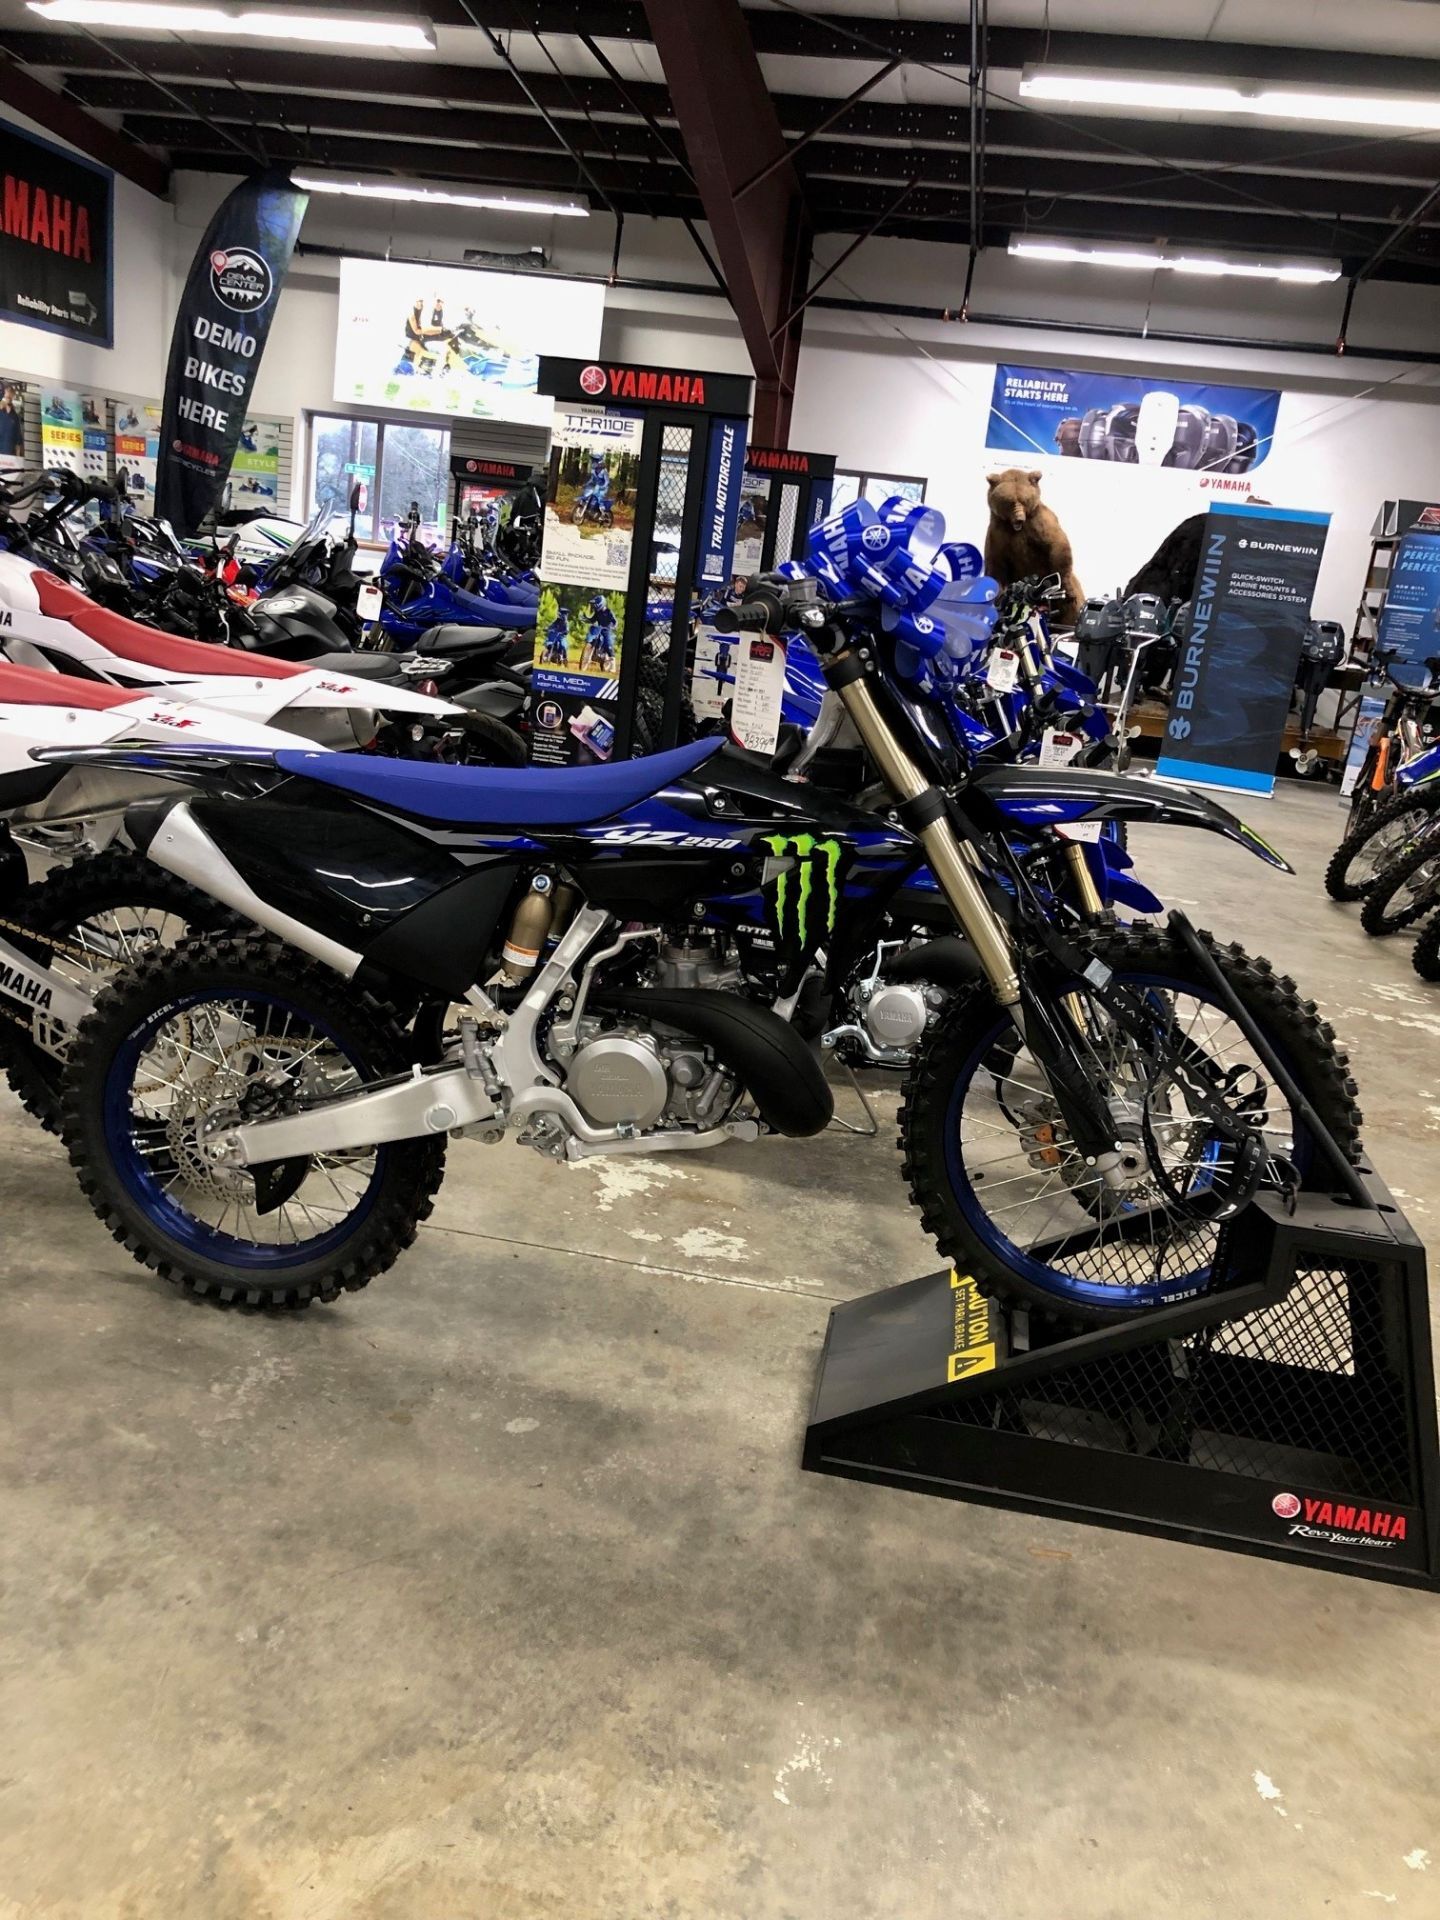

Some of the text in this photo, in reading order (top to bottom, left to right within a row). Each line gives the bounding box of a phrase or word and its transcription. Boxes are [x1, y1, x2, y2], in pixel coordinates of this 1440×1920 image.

[0, 174, 91, 264] MAHA
[219, 277, 264, 291] CENTER
[193, 316, 257, 357] DEMO
[184, 356, 246, 396] BIKES
[609, 368, 705, 405] YAMAHA
[1006, 378, 1066, 392] RELIABILITY
[1004, 387, 1069, 403] STARTS HERE
[178, 396, 229, 432] HERE
[565, 414, 635, 433] TT-R110E
[51, 430, 81, 443] SERIES
[477, 462, 515, 478] YAMAHA
[750, 451, 809, 472] YAMAHA
[711, 424, 735, 550] TRAIL MOTORCYCLE
[1211, 478, 1251, 492] YAMAHA
[1250, 541, 1318, 555] BURNEWIIN
[1229, 580, 1258, 589] MARINE
[1259, 583, 1290, 594] MOUNTS
[1231, 572, 1285, 585] QUICK-SWITCH
[1228, 588, 1307, 603] ACCESSORIES SYSTEM
[1176, 534, 1226, 710] BURNEWIIN
[537, 673, 560, 683] FUEL
[736, 924, 773, 936] GYTR
[147, 1003, 175, 1024] EXCEL
[1160, 1288, 1198, 1303] EXCEL
[953, 1288, 966, 1350] SET PARK BRAKE
[1304, 1498, 1407, 1540] YAMAHA
[1288, 1524, 1394, 1547] Revs Your Heart
